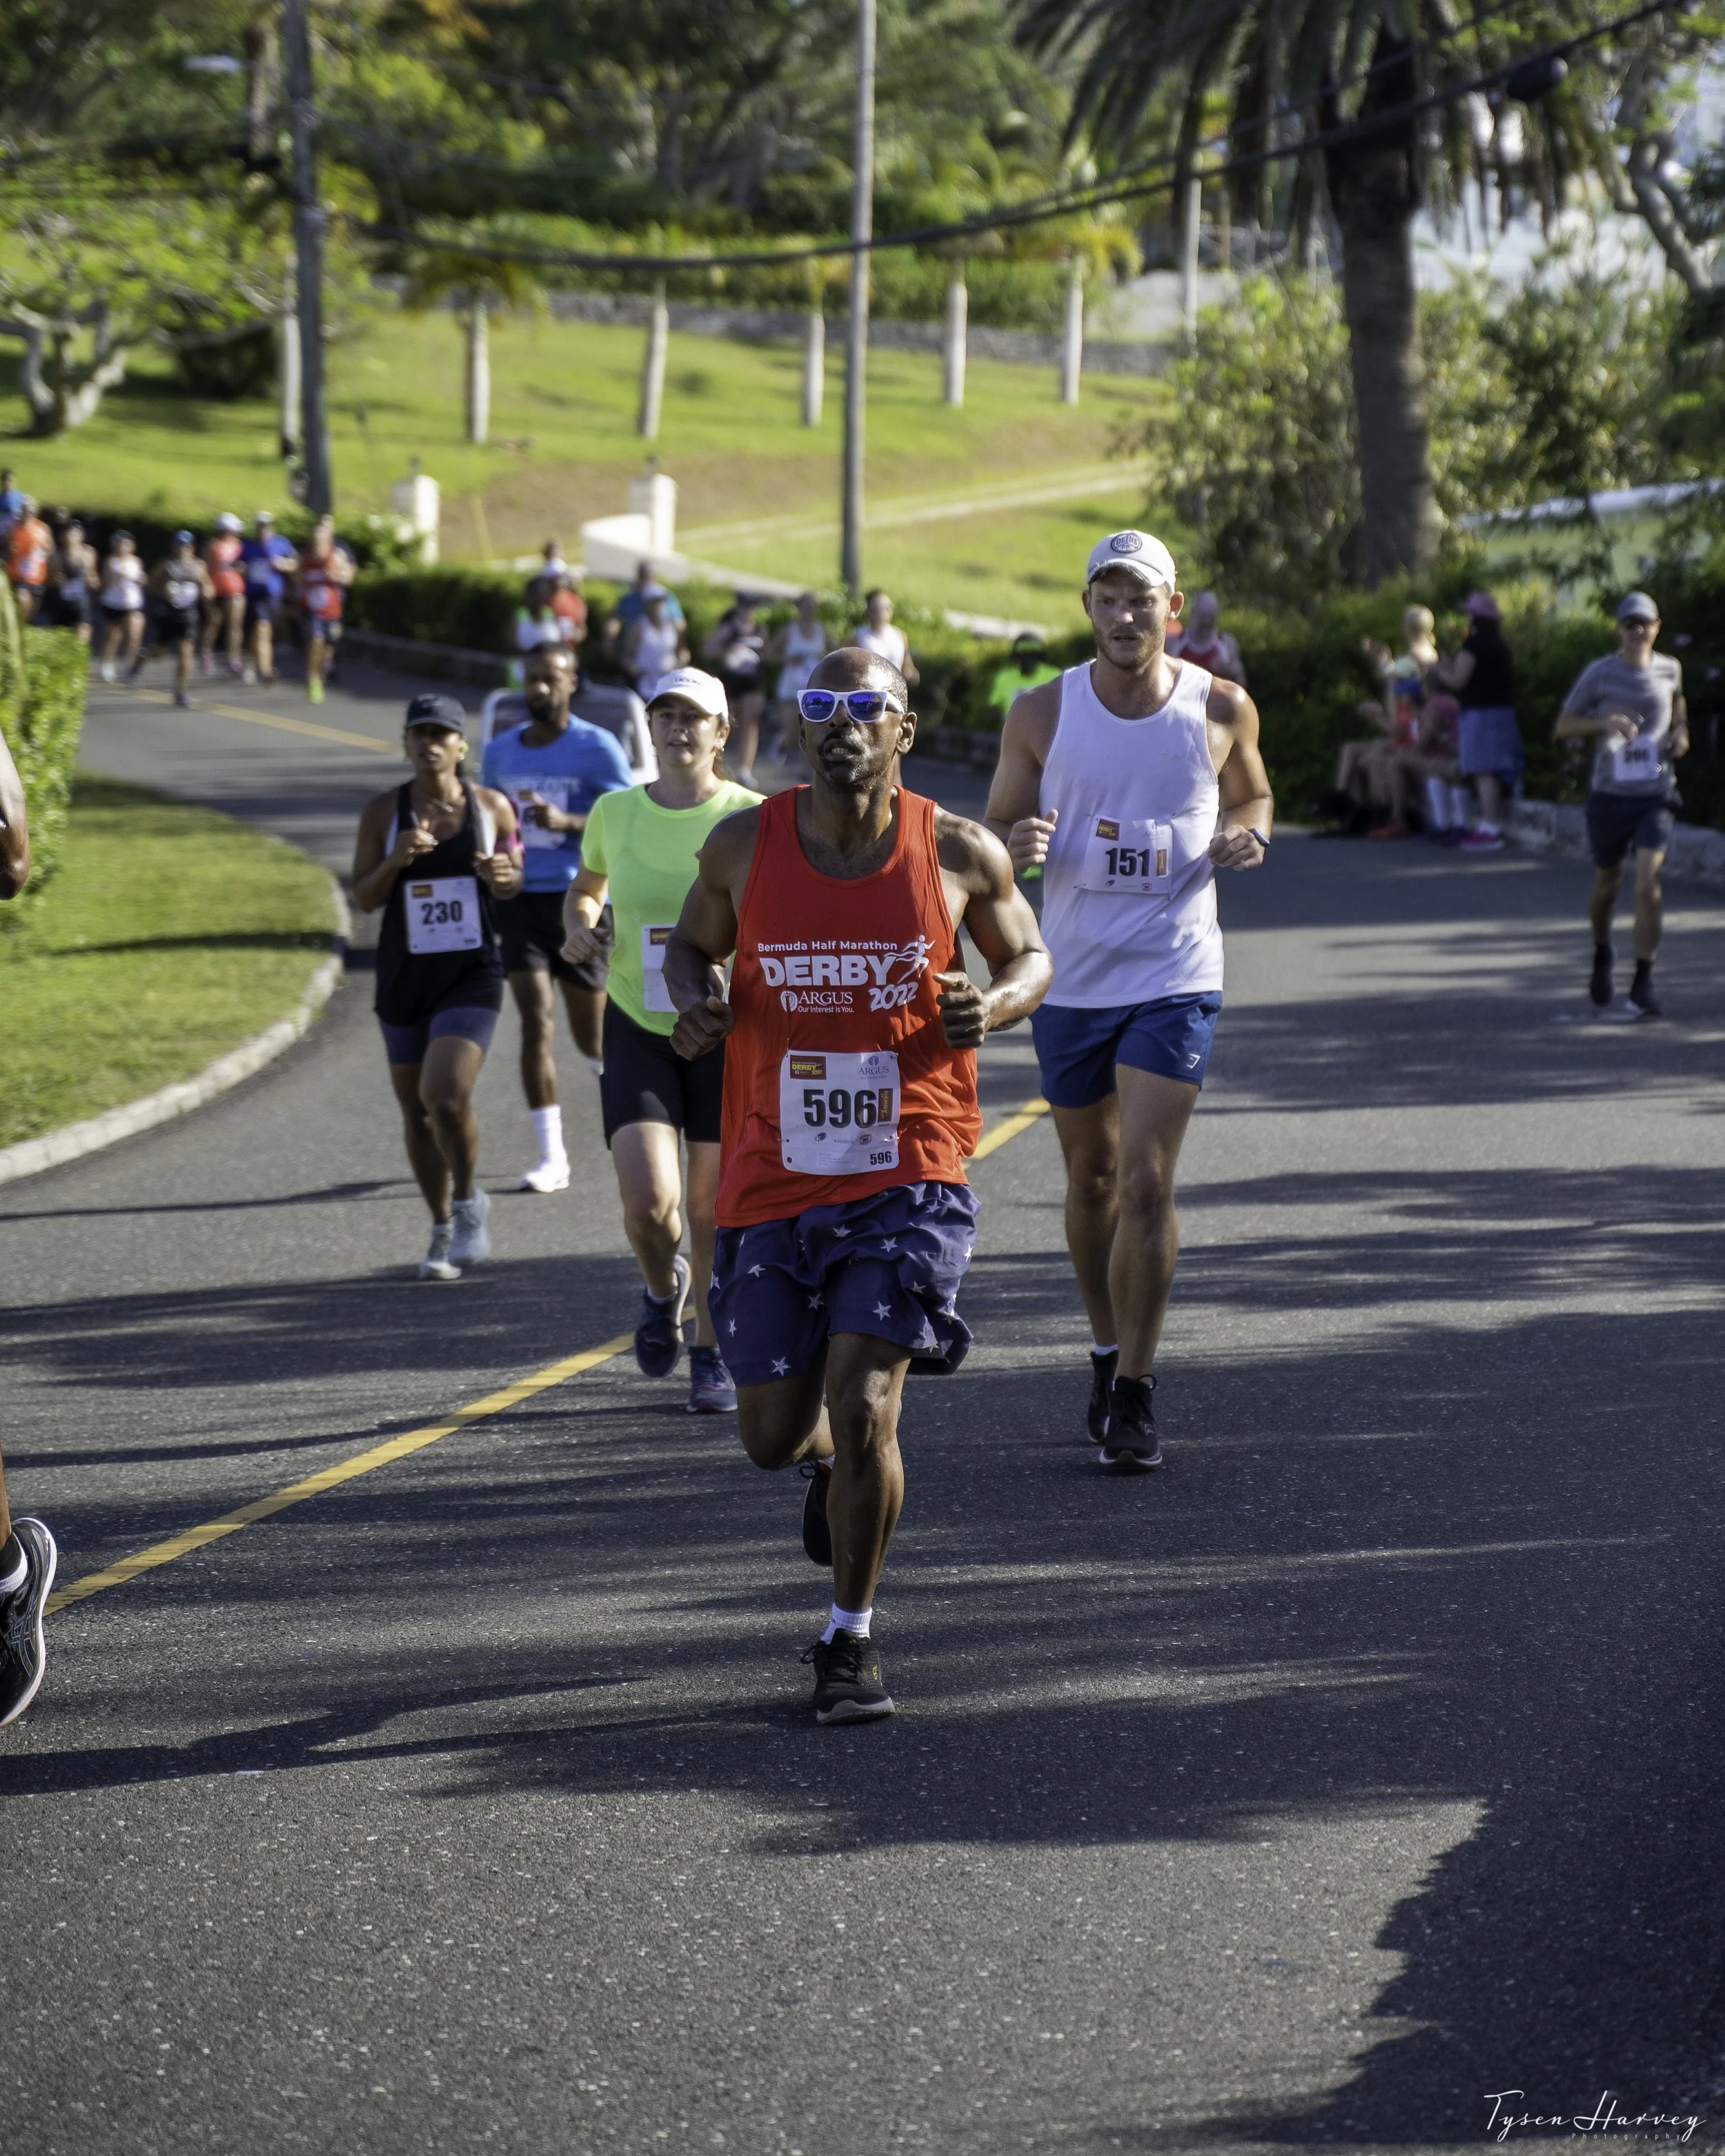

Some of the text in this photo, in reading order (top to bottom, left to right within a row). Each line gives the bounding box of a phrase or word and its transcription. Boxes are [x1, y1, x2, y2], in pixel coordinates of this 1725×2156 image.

[1105, 847, 1150, 877] 151
[421, 900, 462, 925] 230
[758, 940, 897, 952] Bermuda Half Marathon
[759, 955, 896, 987] DERBY
[798, 990, 854, 1006] ARGUS
[868, 982, 919, 1012] 2022
[858, 1066, 889, 1076] ARGUS
[803, 1089, 877, 1129] 596
[869, 1151, 893, 1165] 596
